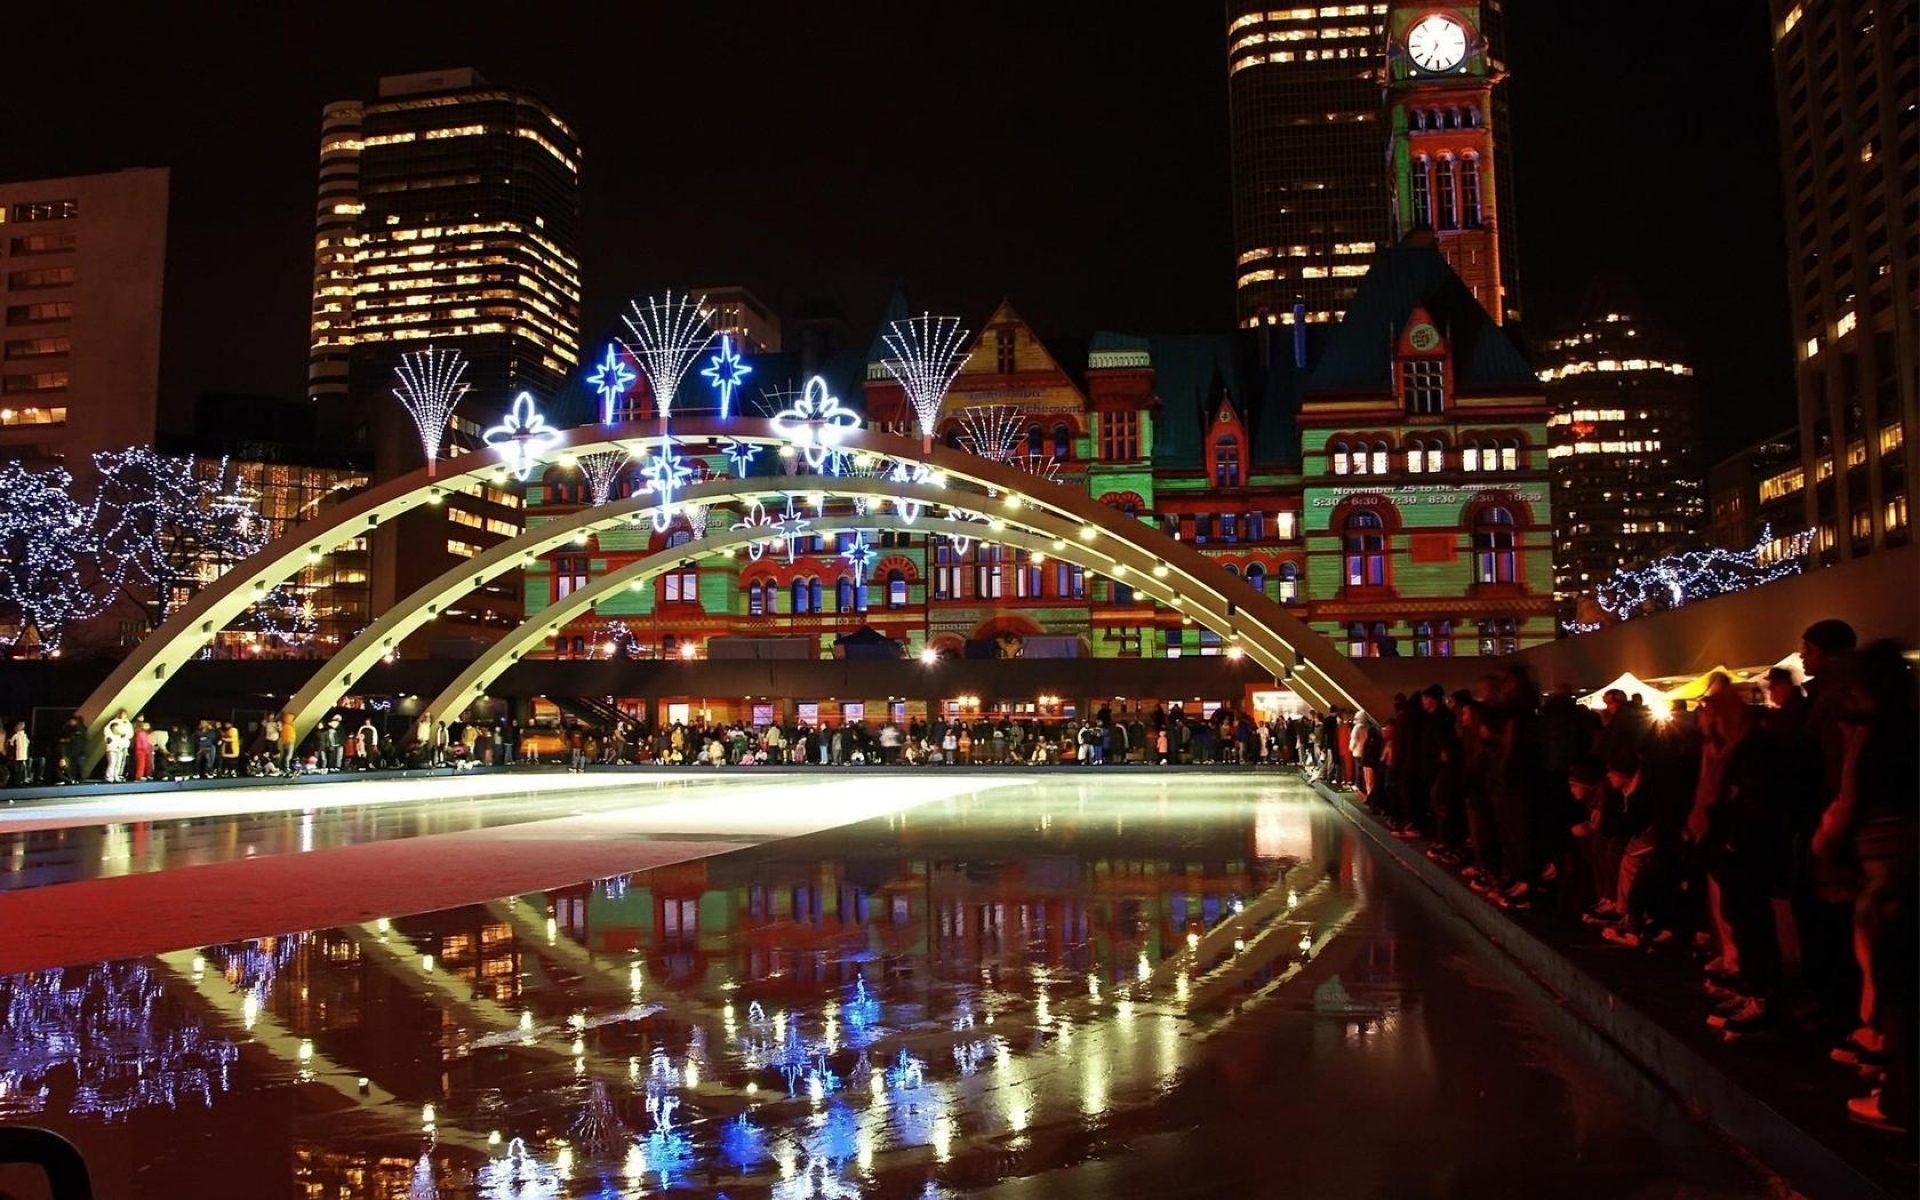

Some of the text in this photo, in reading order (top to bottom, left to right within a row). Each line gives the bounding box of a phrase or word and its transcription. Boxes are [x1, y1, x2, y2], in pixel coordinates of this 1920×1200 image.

[1333, 486, 1396, 496] November
[1400, 485, 1417, 494] 25
[1420, 485, 1432, 493] to
[1313, 497, 1340, 506] 5:30
[1351, 497, 1378, 505] 6:30
[1390, 496, 1417, 505] 7:30
[1428, 495, 1456, 504] 8:30
